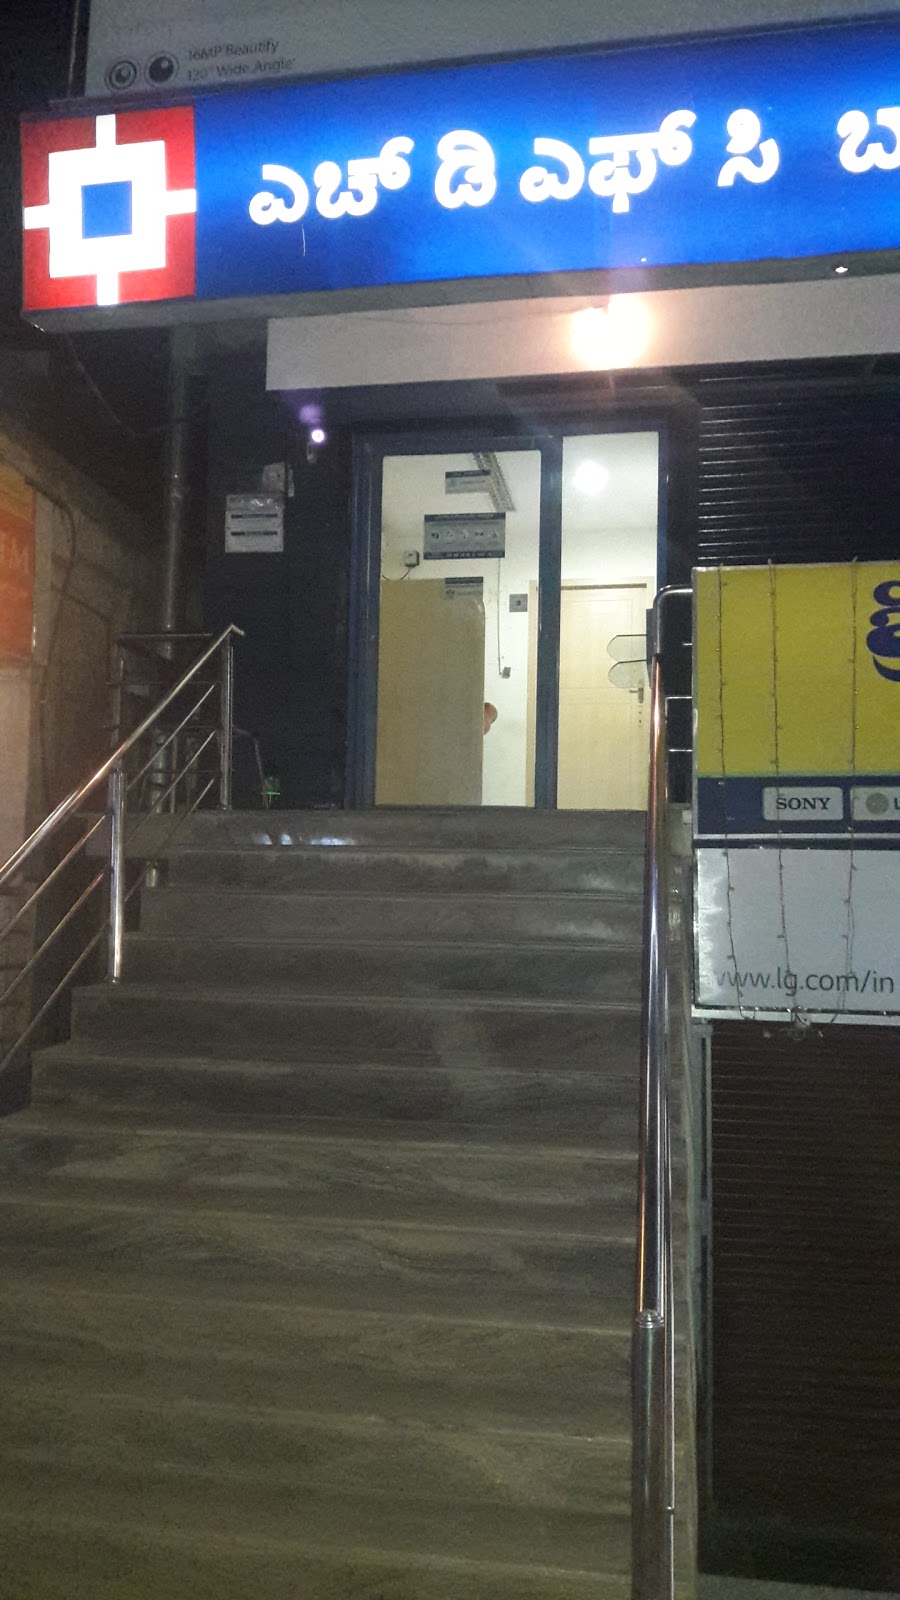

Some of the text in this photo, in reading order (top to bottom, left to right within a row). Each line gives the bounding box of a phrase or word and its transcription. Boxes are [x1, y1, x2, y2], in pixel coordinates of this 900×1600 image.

[227, 39, 278, 56] Beautify
[217, 63, 249, 77] Wide
[249, 136, 414, 225] ಎಚ್
[434, 129, 496, 209] ಡಿ
[519, 109, 697, 213] ಎಫ್
[717, 108, 780, 187] ಸಿ
[776, 797, 831, 810] SONY
[717, 966, 894, 997] www.lg.com/in
